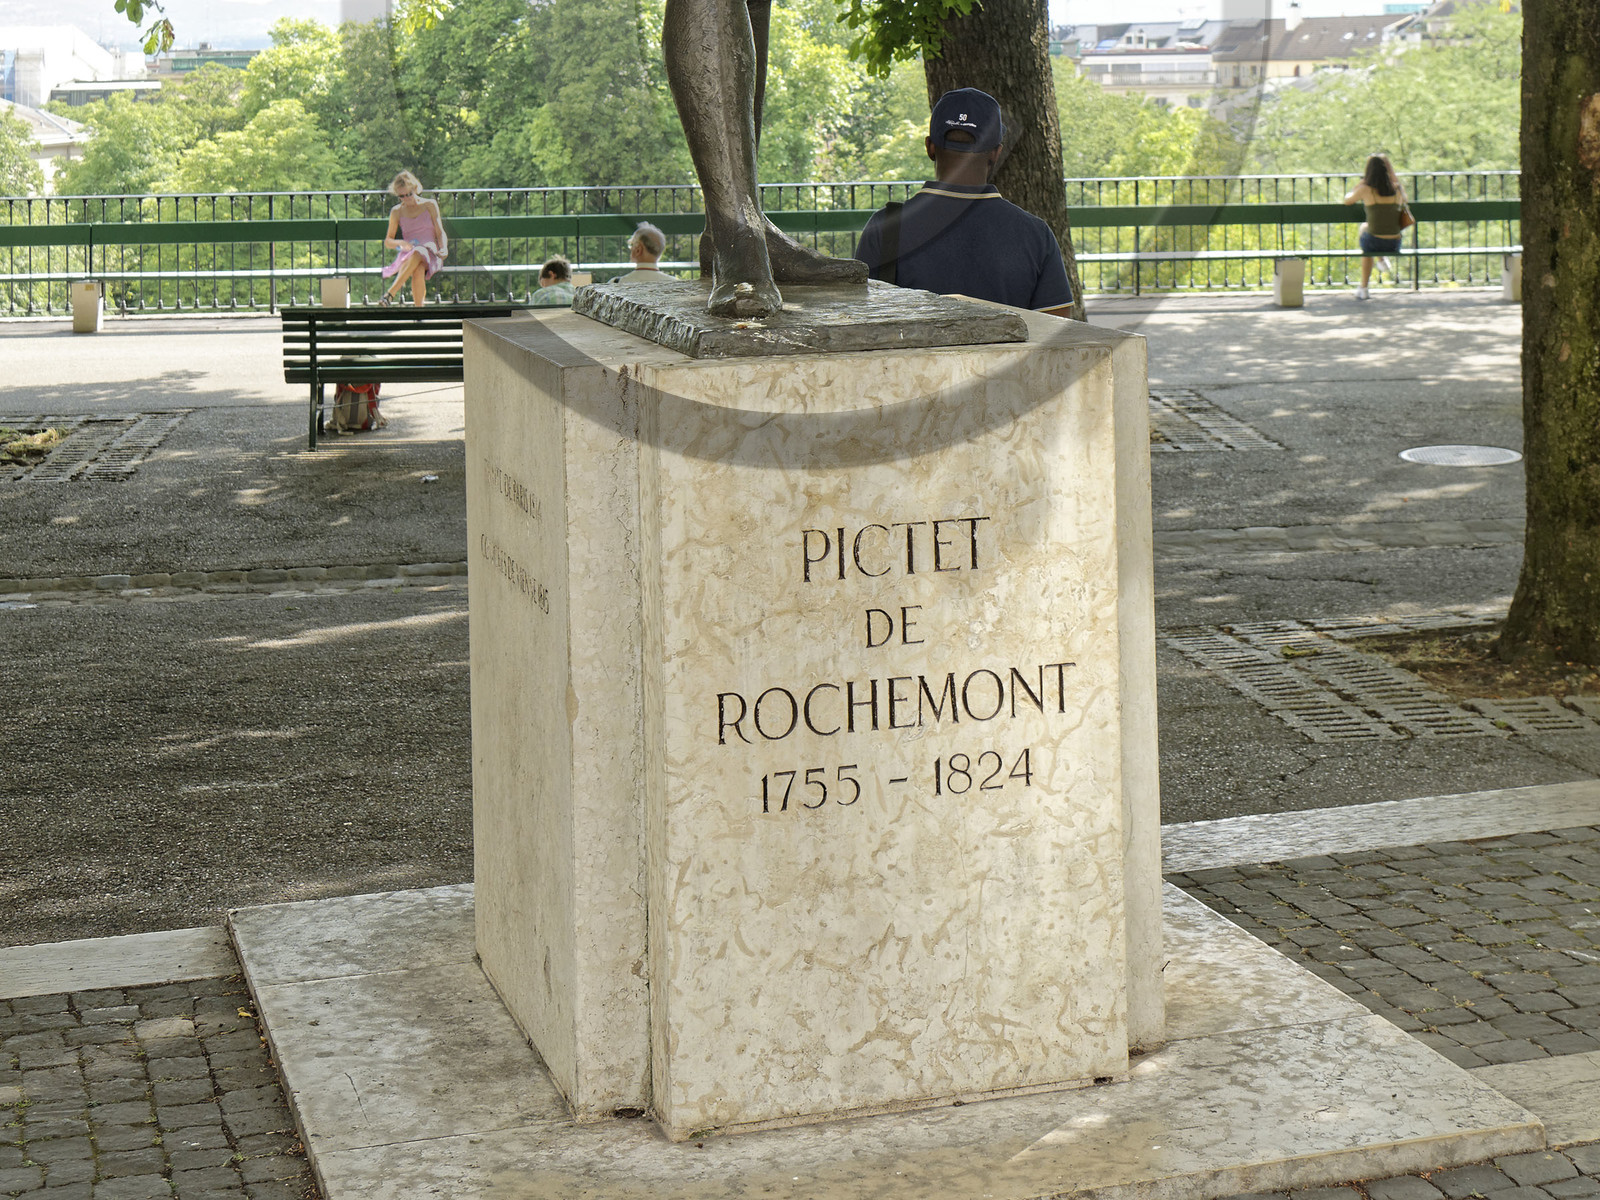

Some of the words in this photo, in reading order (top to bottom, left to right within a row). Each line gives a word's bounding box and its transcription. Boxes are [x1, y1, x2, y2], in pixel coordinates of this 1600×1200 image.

[801, 517, 991, 583] PICTET
[865, 604, 925, 649] DE
[716, 662, 1077, 746] ROCHEMONT
[761, 764, 861, 814] 1755
[933, 748, 1033, 797] 1824
